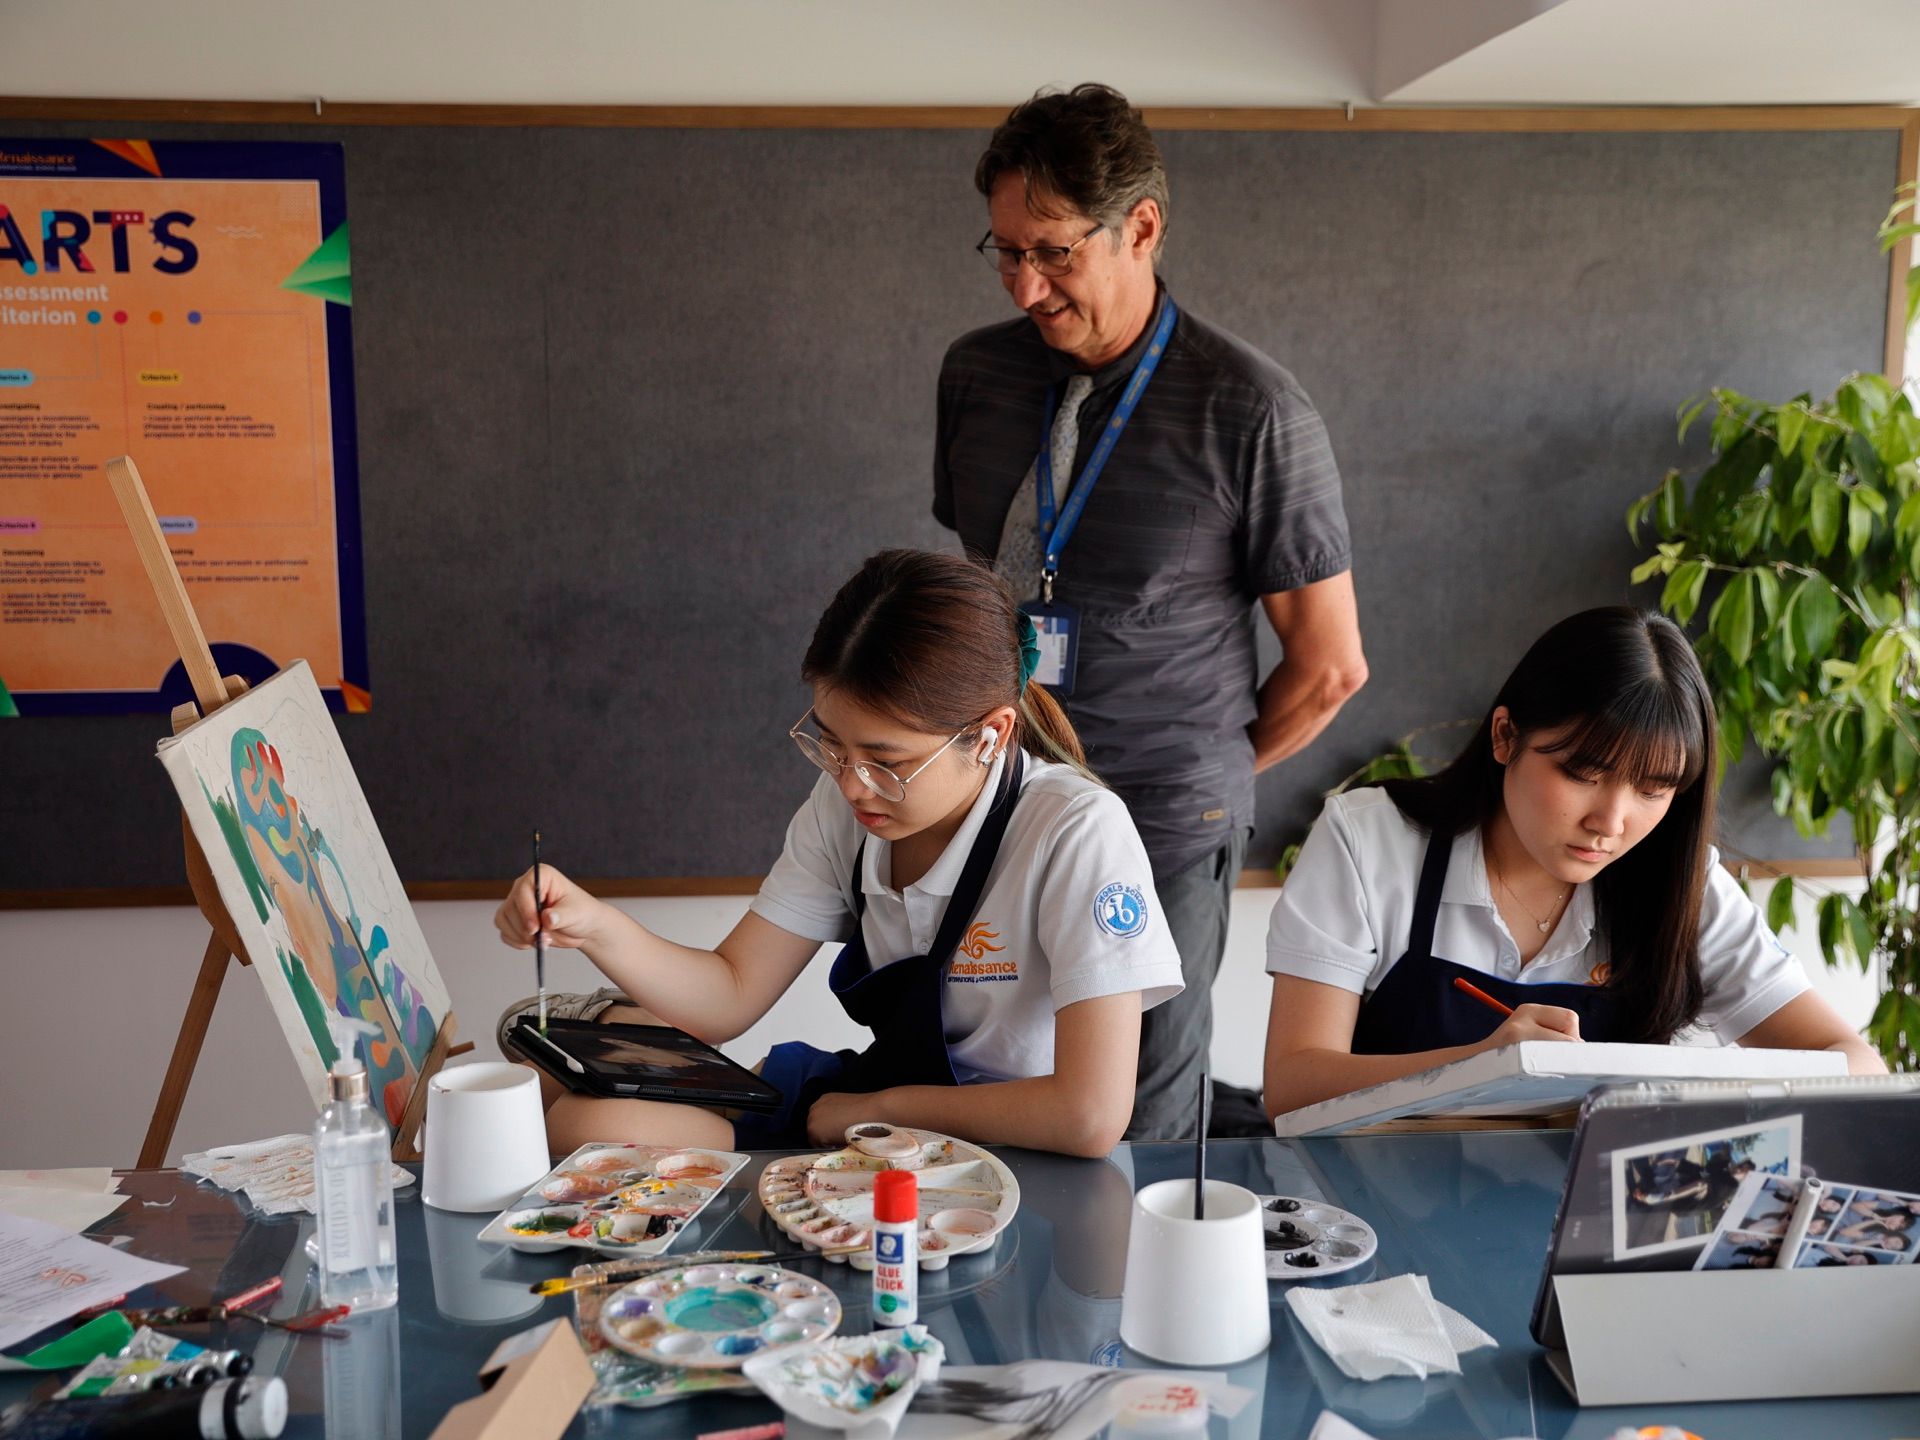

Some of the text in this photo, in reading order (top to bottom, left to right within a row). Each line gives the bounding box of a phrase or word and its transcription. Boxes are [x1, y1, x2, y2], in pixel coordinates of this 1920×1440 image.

[0, 151, 76, 165] enaissance
[0, 285, 109, 302] sessment
[0, 307, 77, 325] iterion
[1097, 885, 1145, 916] WORLD SCHOOL
[949, 961, 1017, 974] Renaissance
[878, 1264, 901, 1278] GLUE
[876, 1278, 904, 1291] STICK
